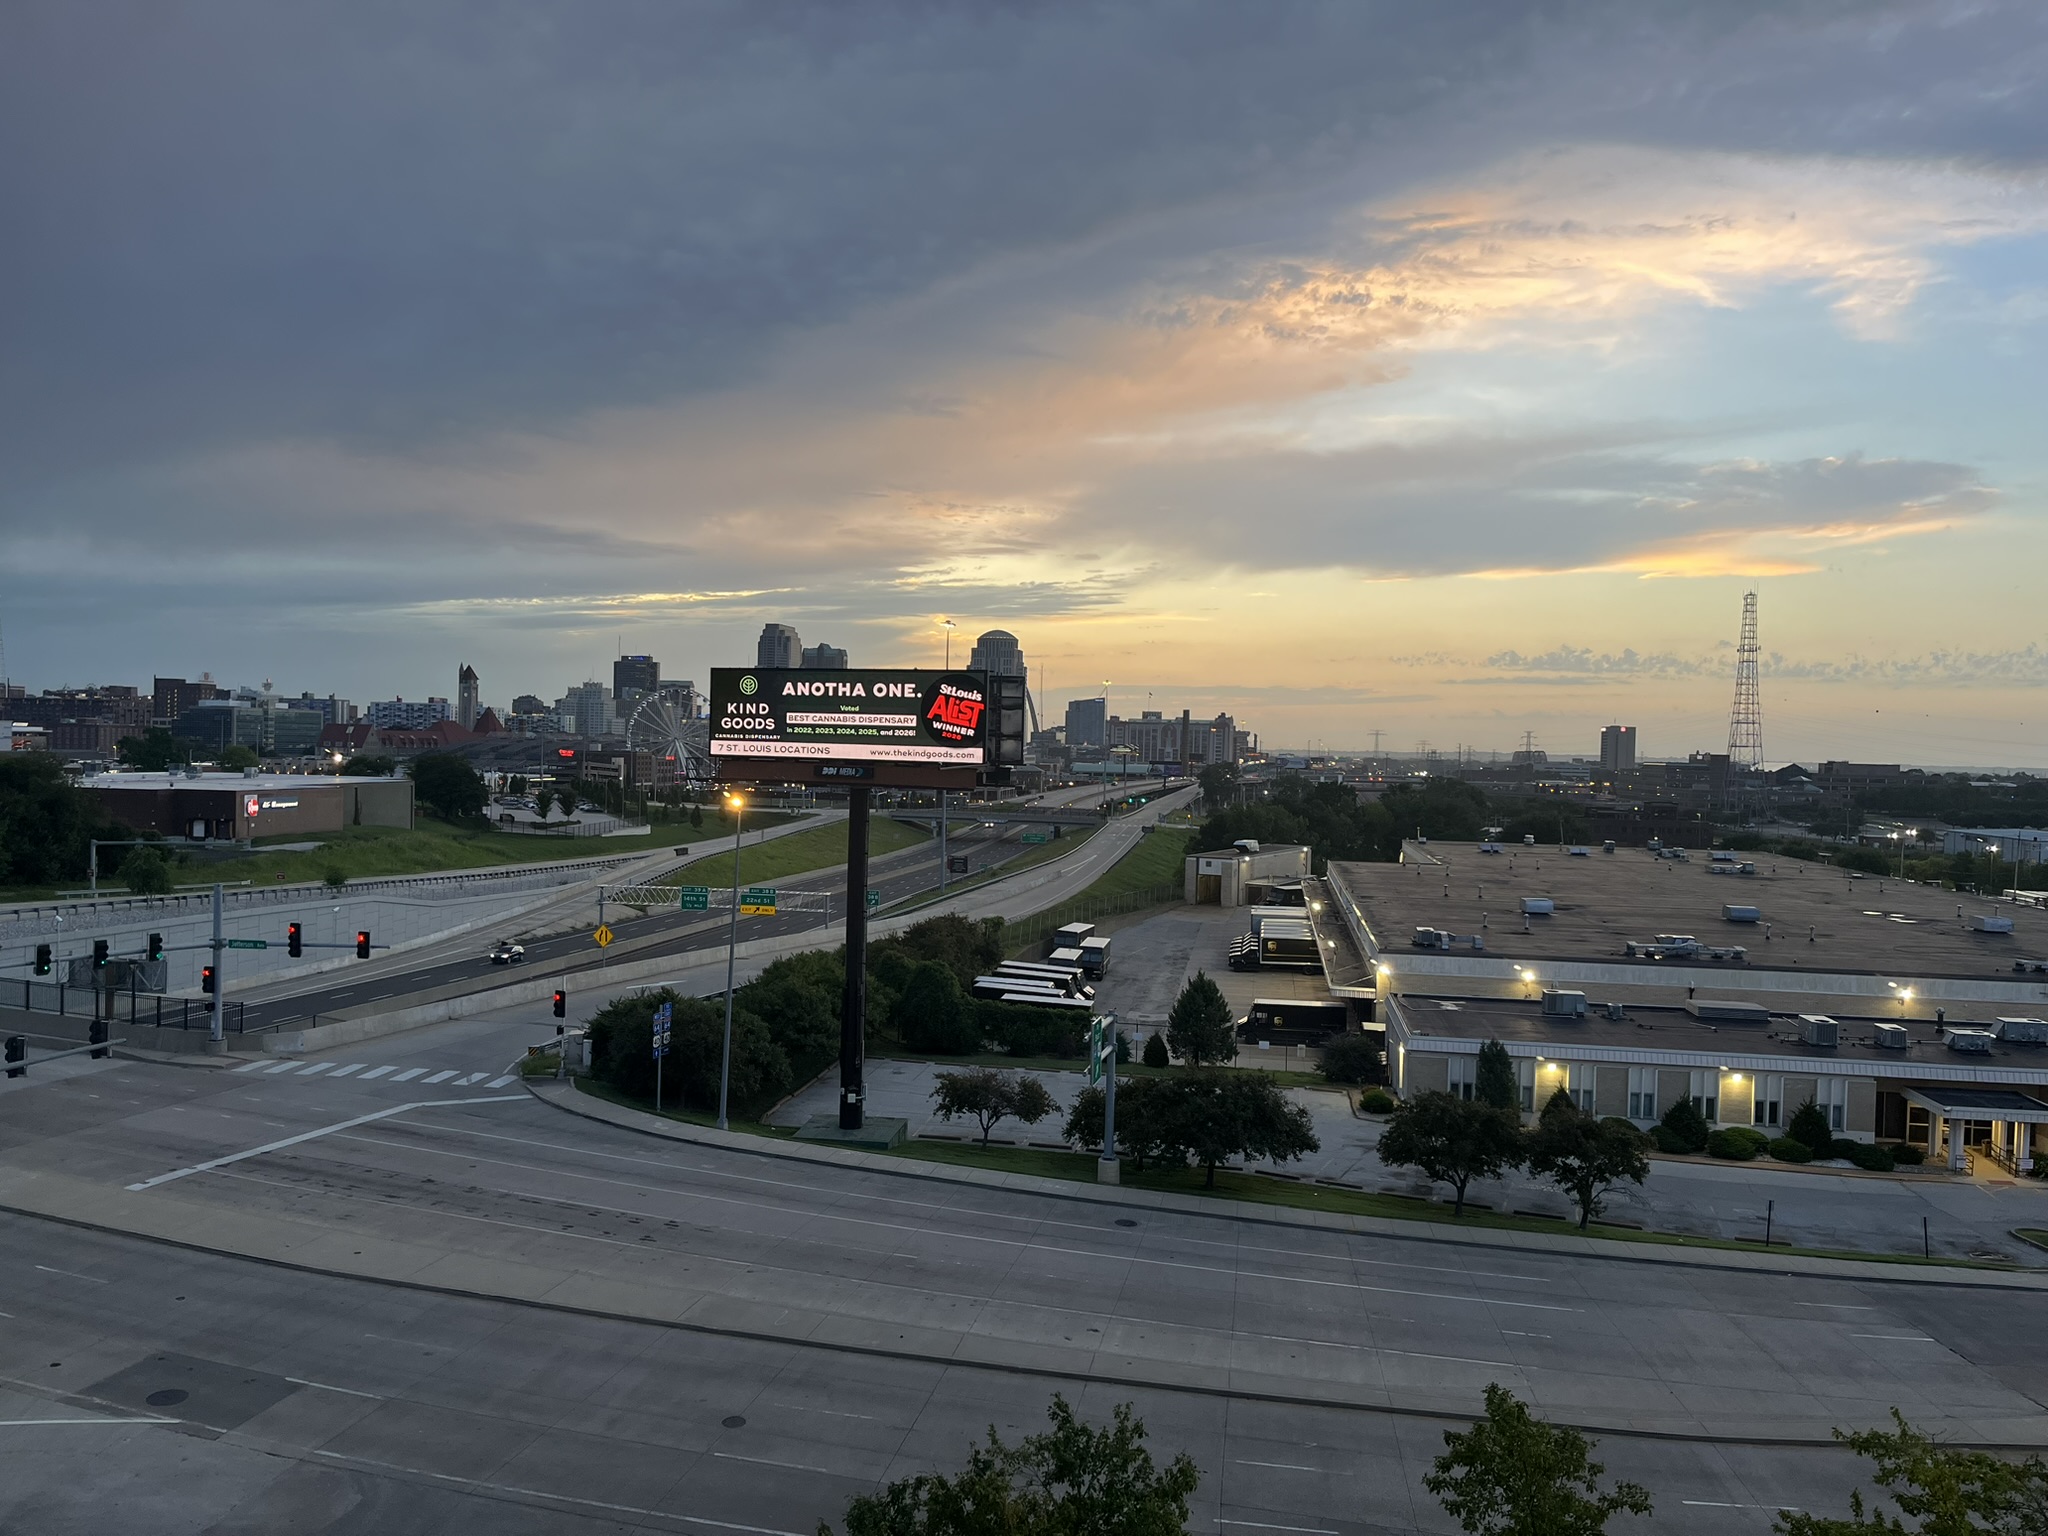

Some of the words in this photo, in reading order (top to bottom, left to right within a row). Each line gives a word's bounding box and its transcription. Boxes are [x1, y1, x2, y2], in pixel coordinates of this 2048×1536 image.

[782, 681, 866, 697] ANOTHA
[873, 683, 922, 698] ONE.
[727, 702, 770, 715] KIND
[840, 704, 860, 712] Voted
[721, 717, 776, 731] GOODS
[788, 714, 810, 722] BEST
[811, 715, 857, 723] CANNABIS
[858, 716, 915, 725] DISPENSARY
[793, 726, 814, 734] 2022,
[815, 727, 836, 735] 2023,
[836, 728, 857, 736] 2024,
[858, 728, 879, 736] 2025,
[932, 720, 975, 737] WINNER
[726, 744, 740, 752] ST.
[743, 745, 771, 753] LOUIS
[774, 745, 831, 755] LOCATIONS
[869, 748, 975, 760] www.thekindgoods.com
[838, 767, 856, 776] MEDIA
